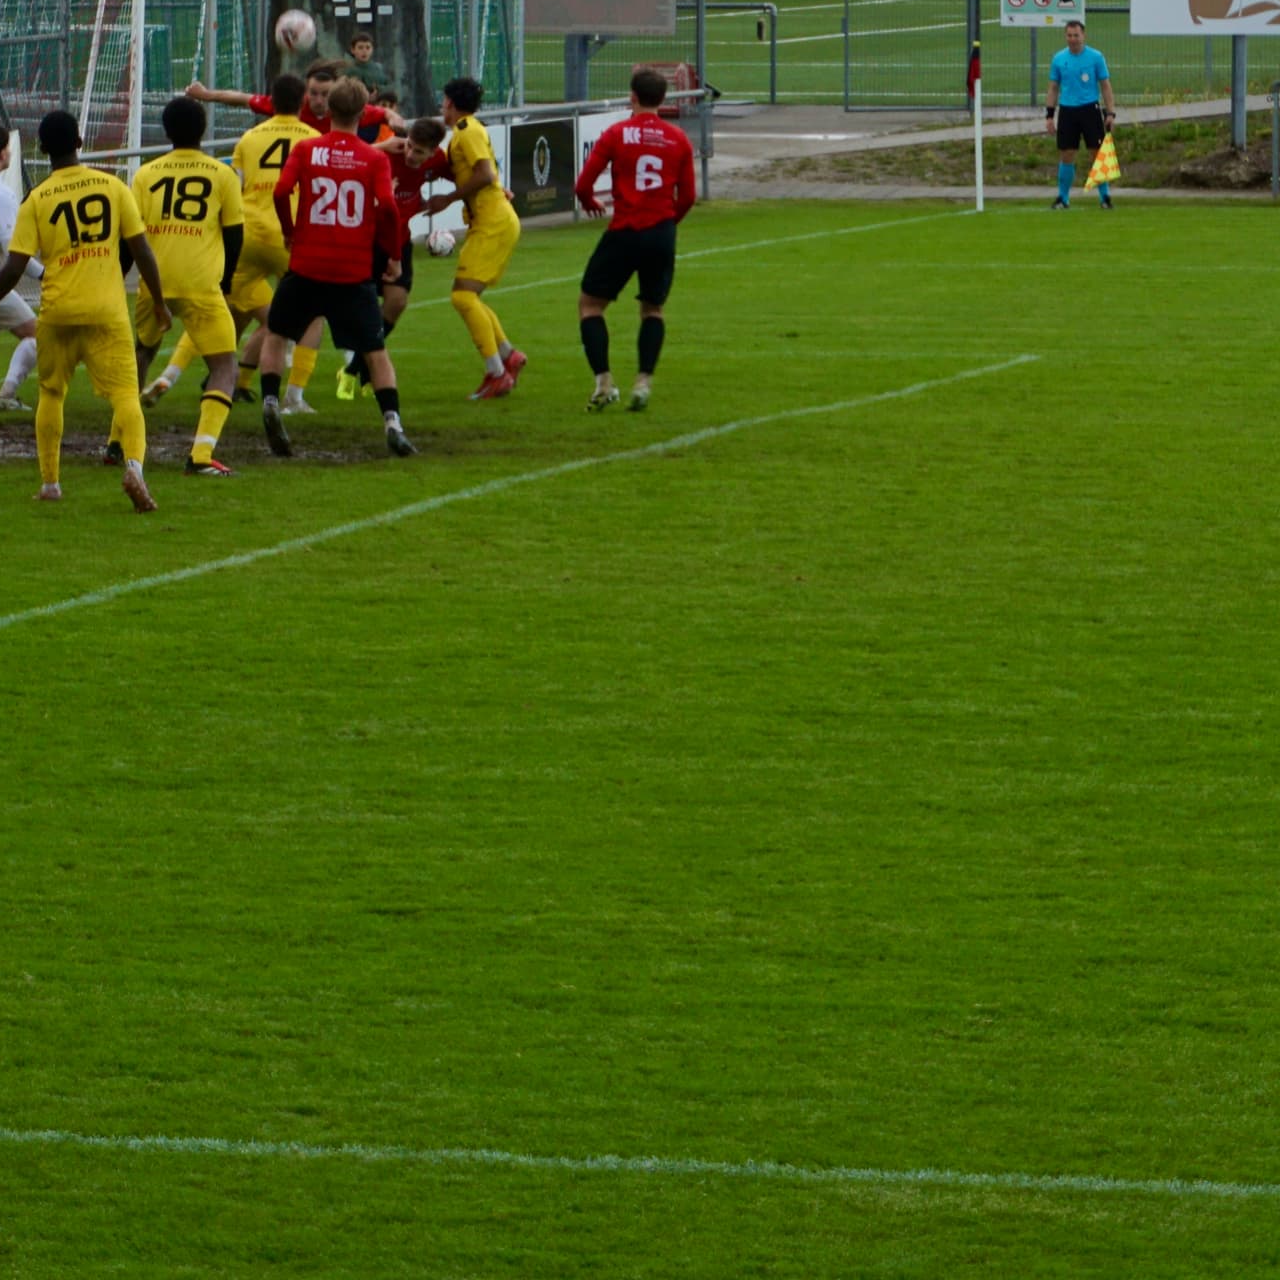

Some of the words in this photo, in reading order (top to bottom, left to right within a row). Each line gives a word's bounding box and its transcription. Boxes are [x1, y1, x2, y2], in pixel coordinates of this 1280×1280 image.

[259, 138, 291, 169] 4
[635, 153, 663, 192] 6
[149, 176, 212, 221] 18
[310, 176, 365, 228] 20
[49, 193, 111, 248] 19
[146, 223, 203, 237] RAIFFEISEN
